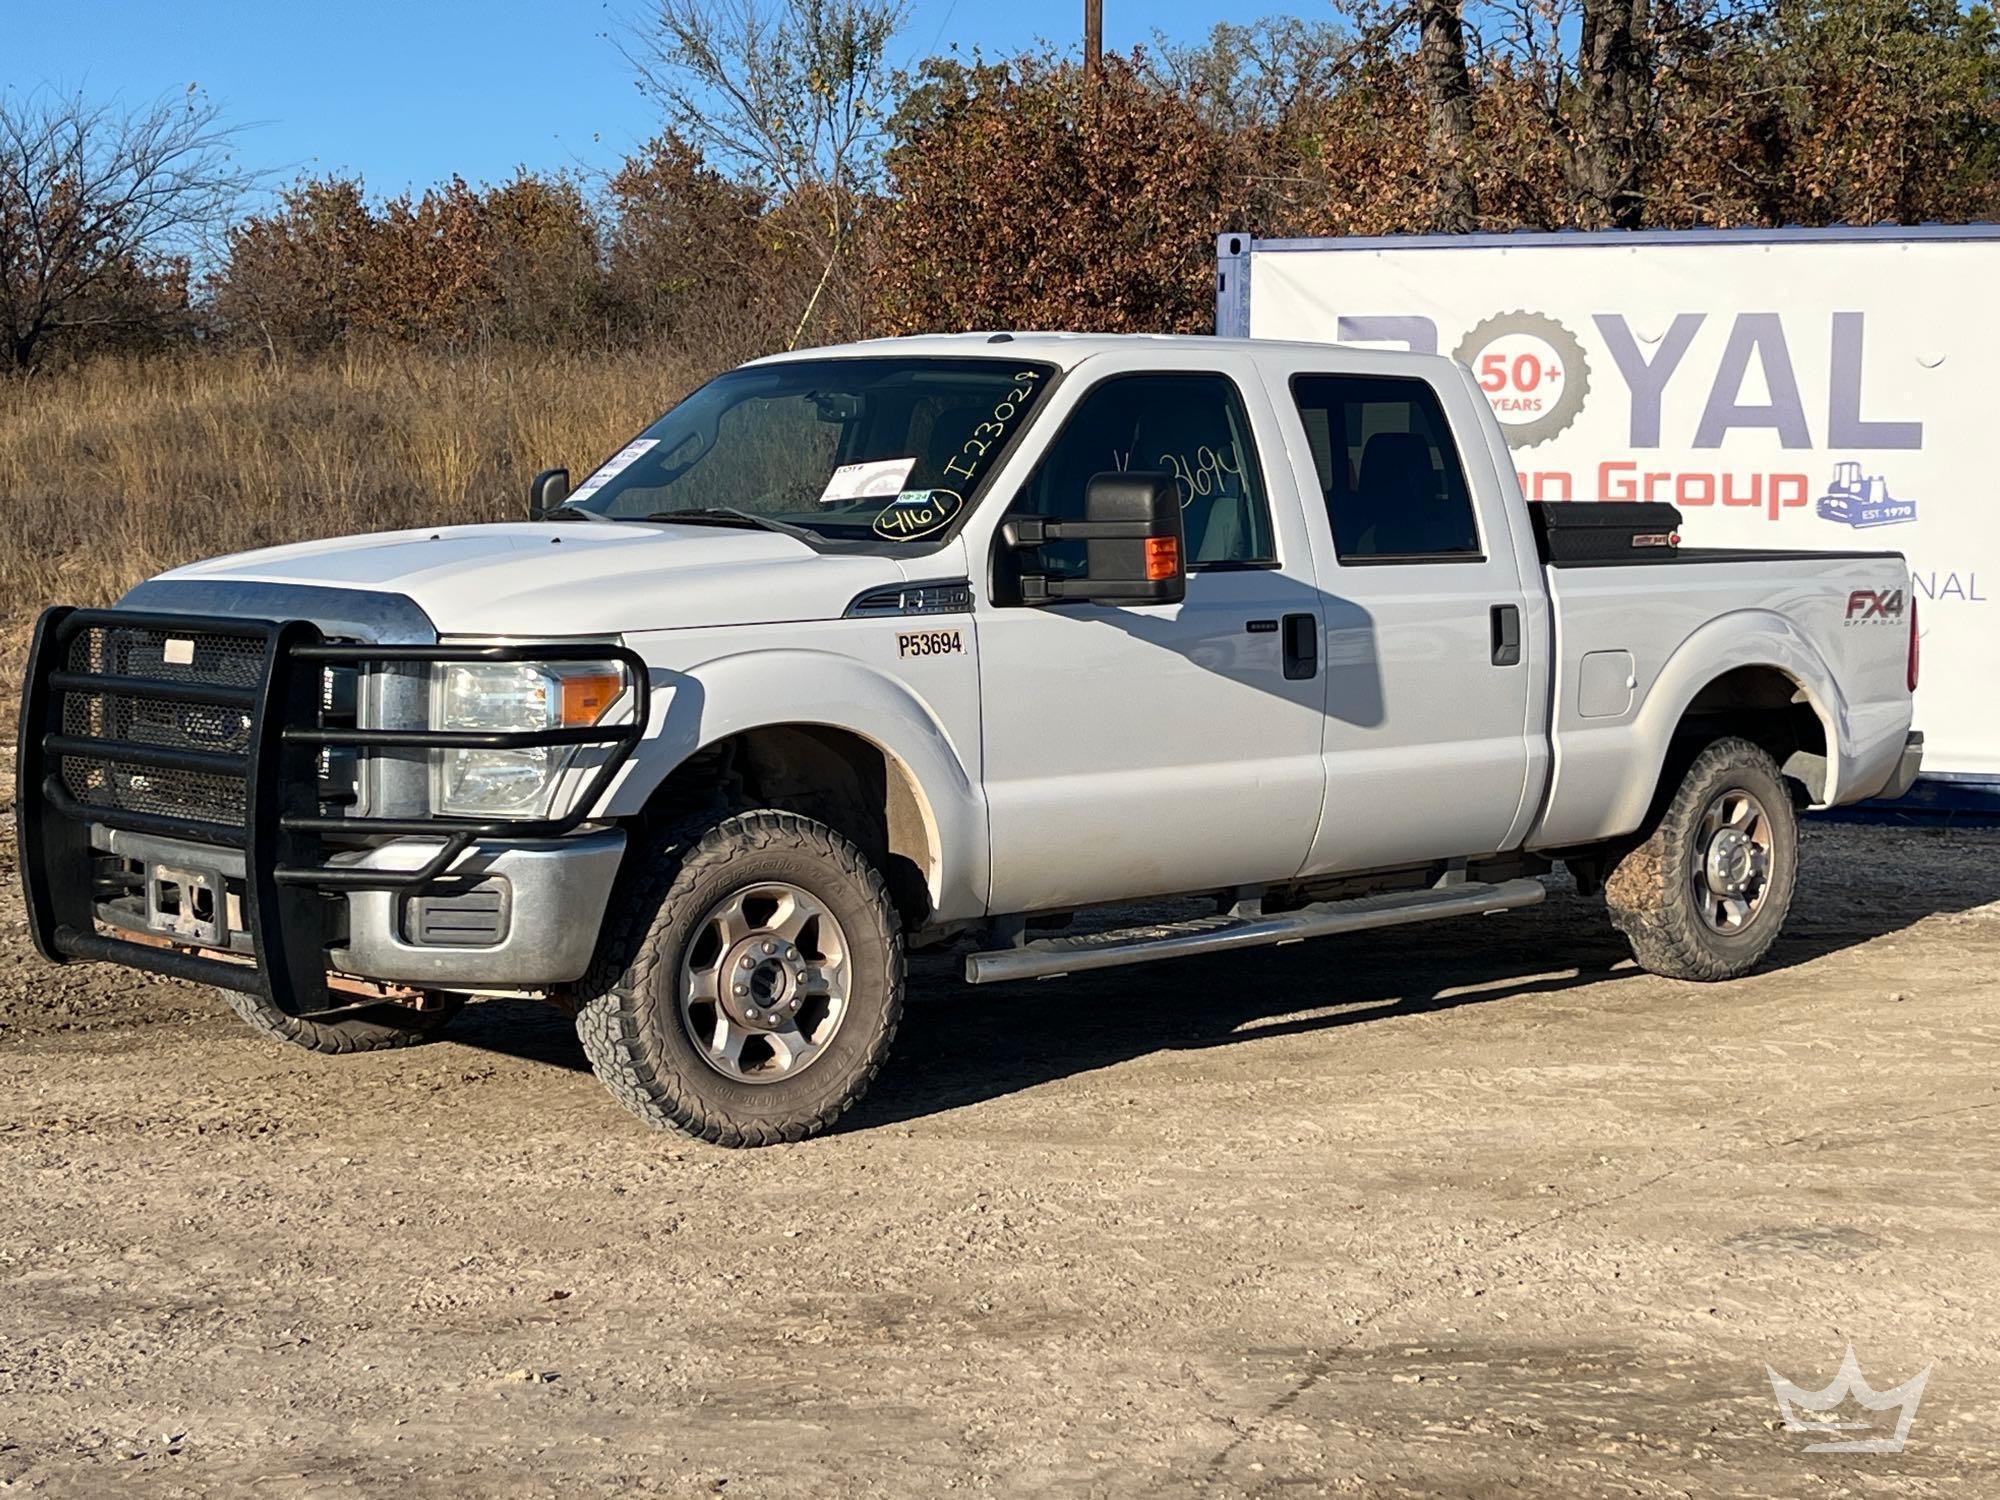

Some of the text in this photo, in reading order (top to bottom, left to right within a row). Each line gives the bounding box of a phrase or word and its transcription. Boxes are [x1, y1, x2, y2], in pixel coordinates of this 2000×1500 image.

[1479, 353, 1561, 393] 50+
[1490, 398, 1543, 411] YEARS
[1597, 461, 1809, 521] Group
[881, 495, 946, 533] 4161
[1883, 506, 1912, 518] 1970
[1845, 589, 1905, 620] FX4
[898, 631, 962, 657] P53694
